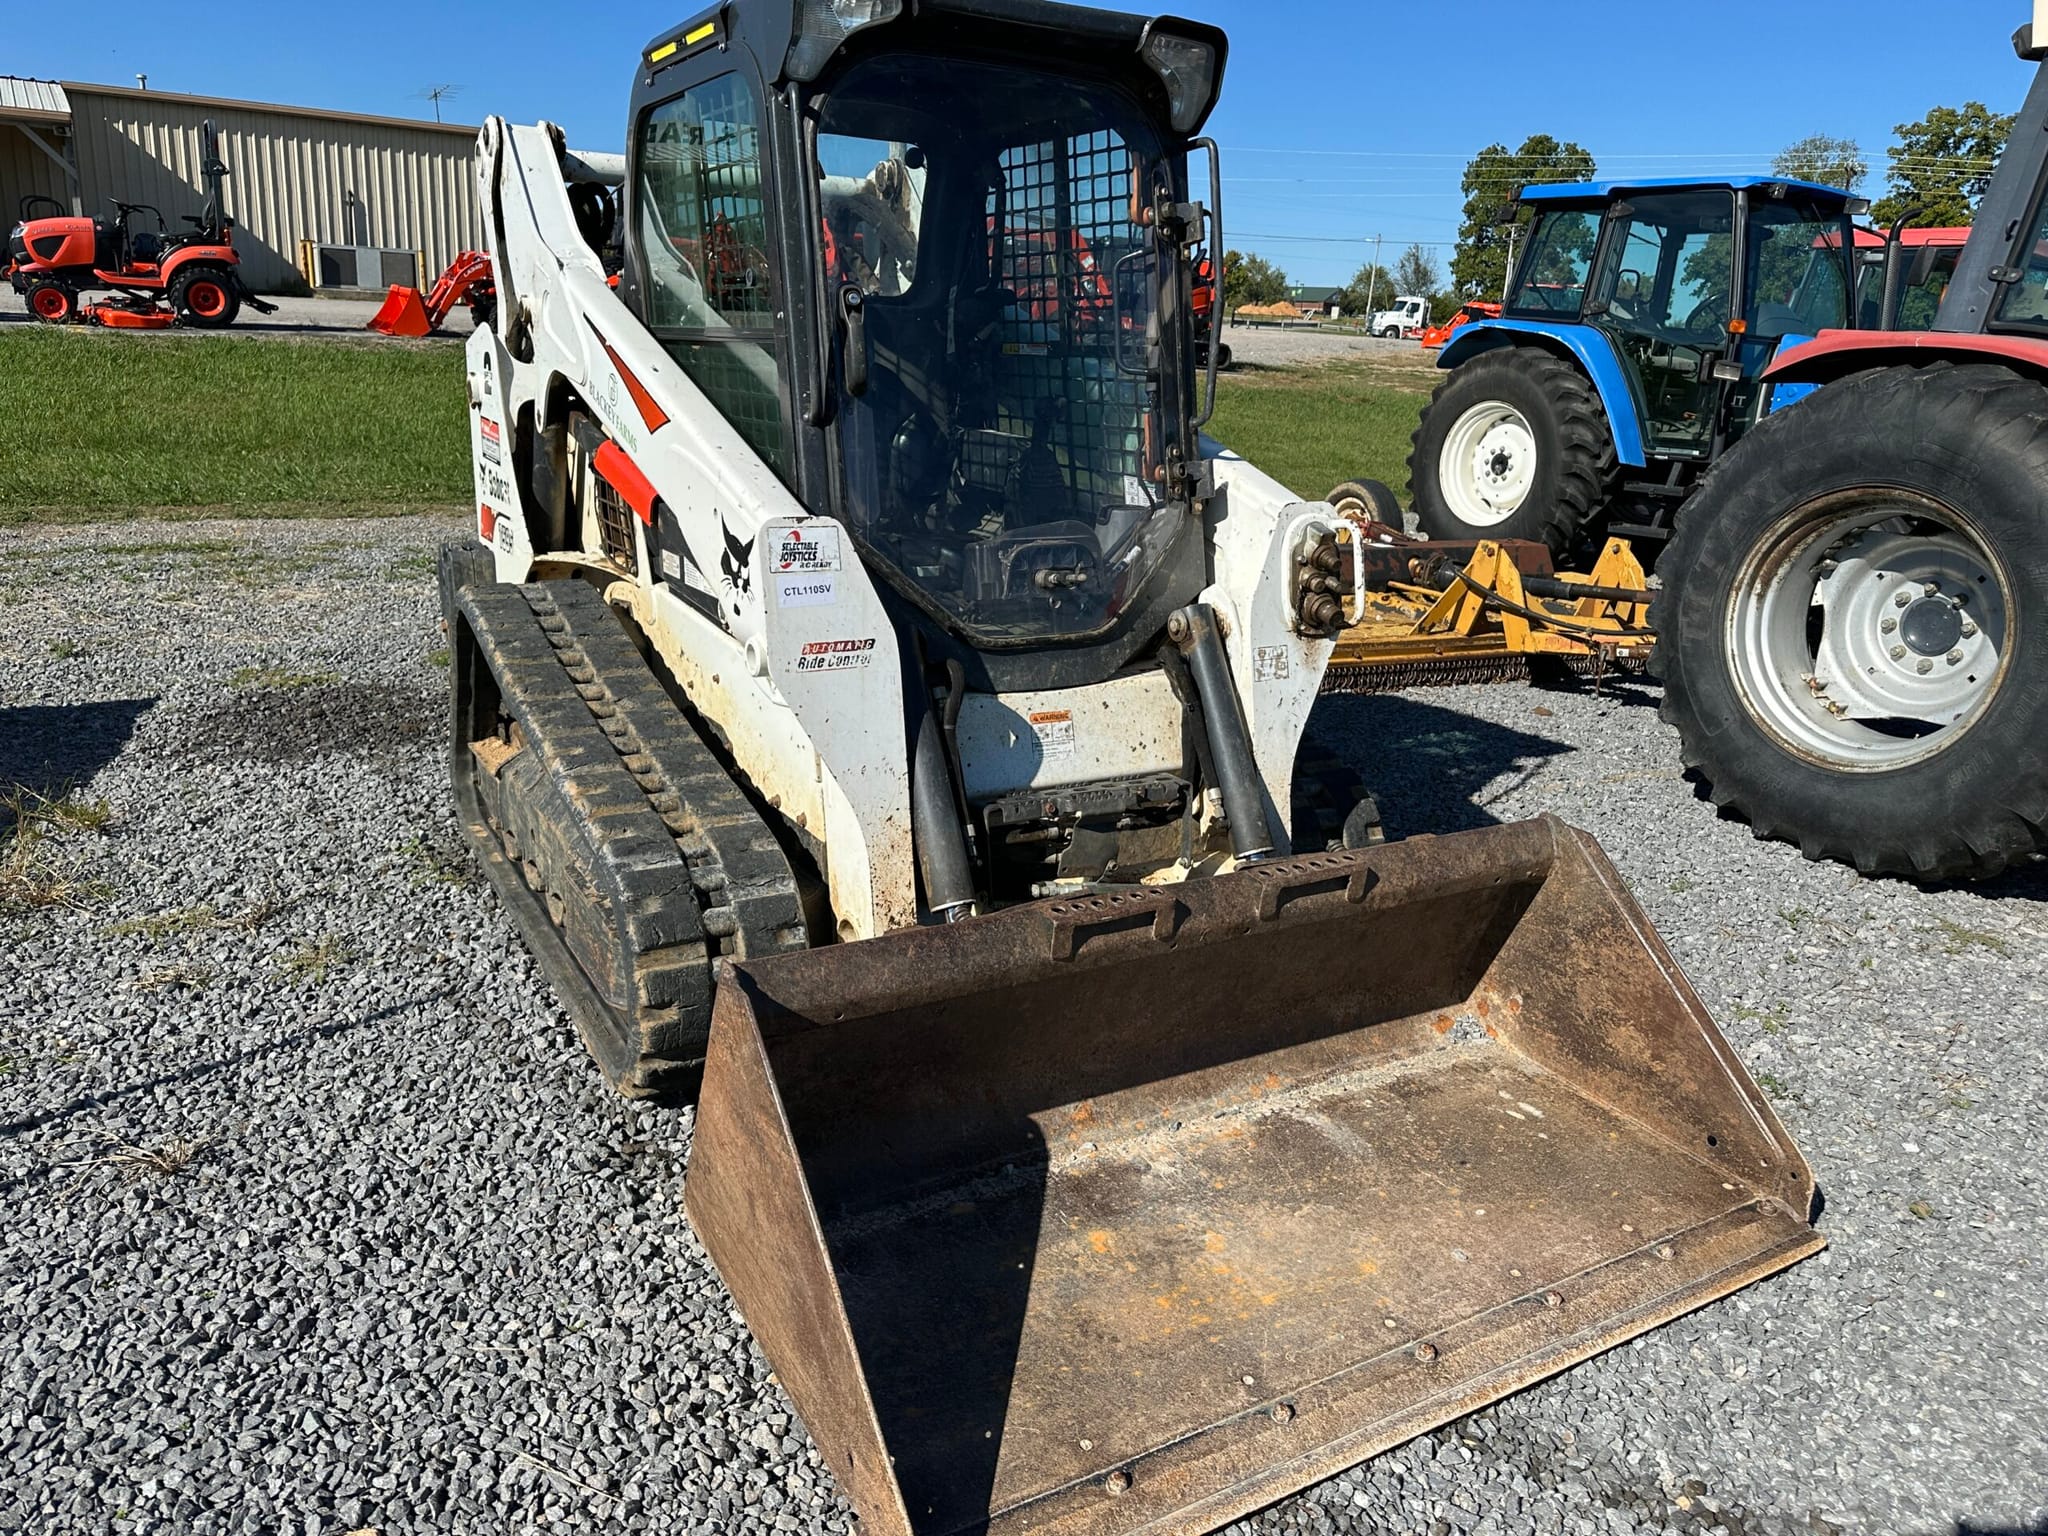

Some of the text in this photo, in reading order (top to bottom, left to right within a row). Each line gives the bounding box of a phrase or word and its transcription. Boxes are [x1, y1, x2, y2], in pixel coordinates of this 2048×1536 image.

[781, 541, 819, 551] SELECTABLE
[779, 550, 818, 562] JOYSTICKS
[784, 583, 832, 597] CTL110SV
[803, 640, 873, 654] AUTOMATIC
[797, 655, 825, 670] Ride
